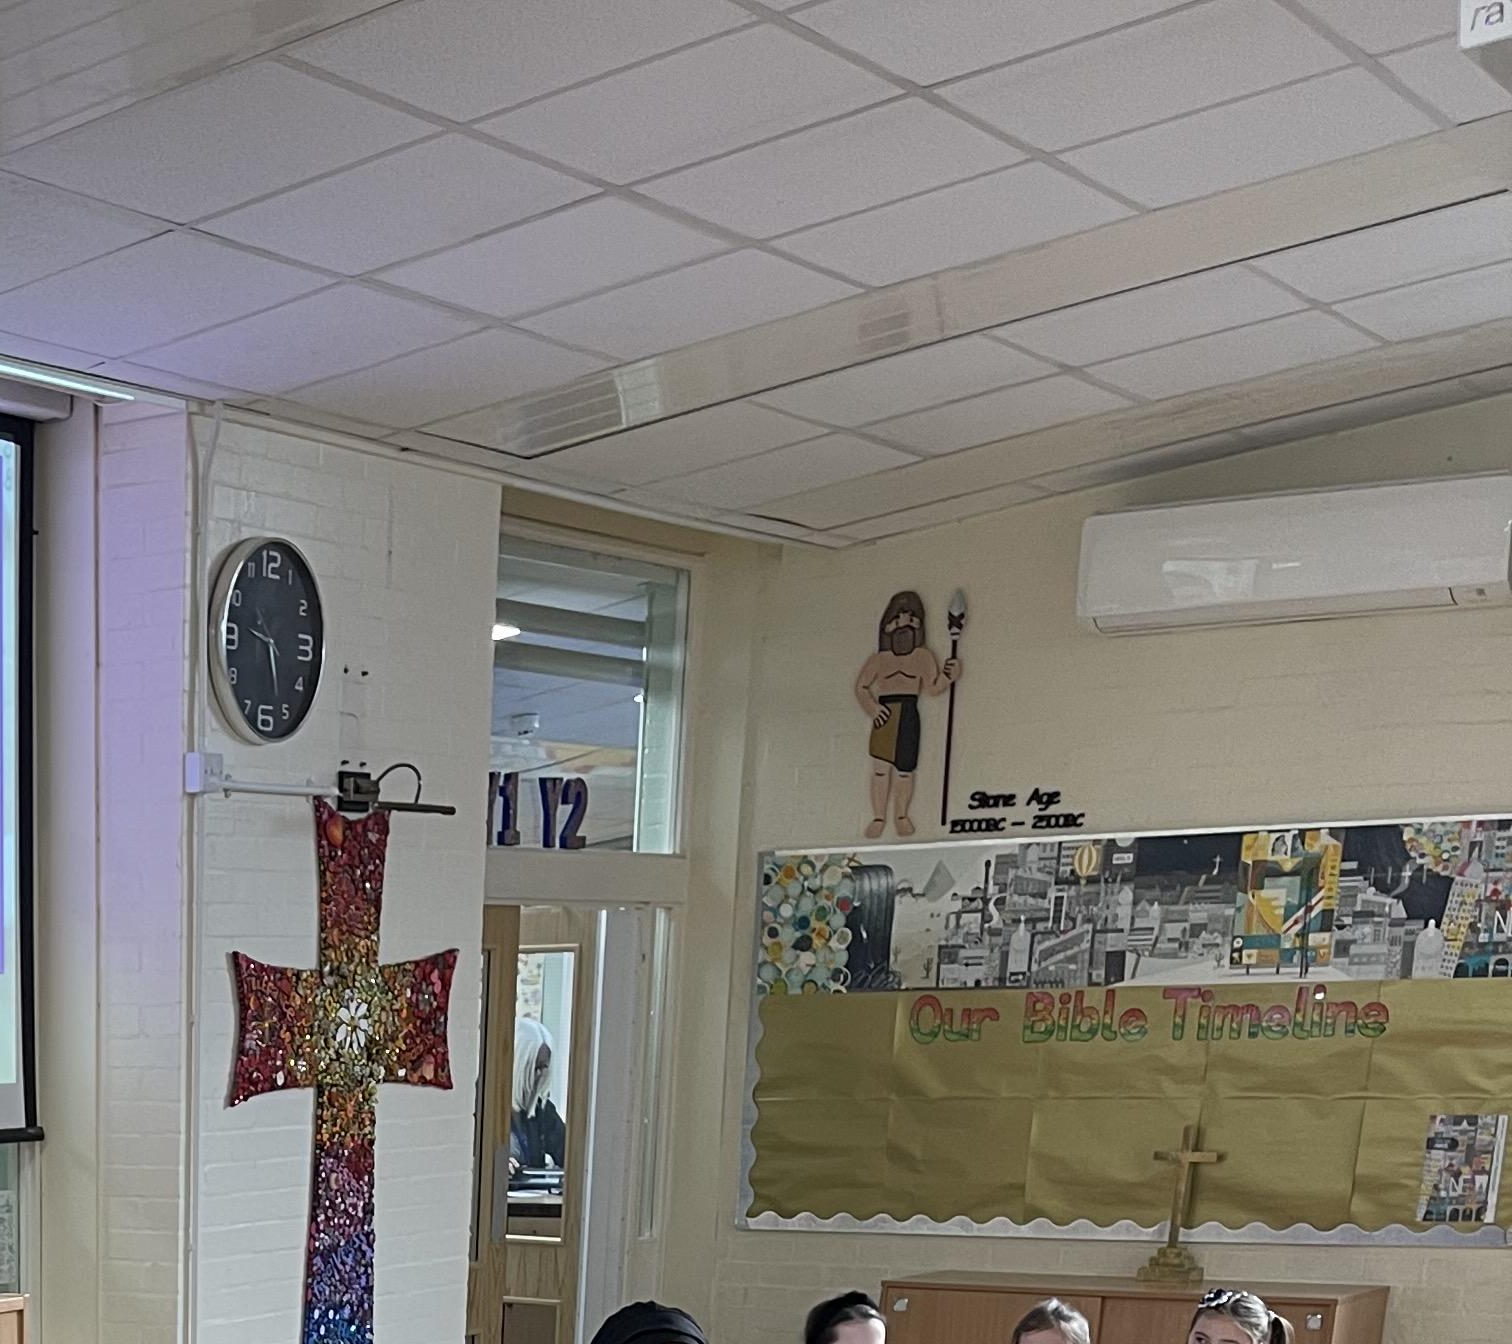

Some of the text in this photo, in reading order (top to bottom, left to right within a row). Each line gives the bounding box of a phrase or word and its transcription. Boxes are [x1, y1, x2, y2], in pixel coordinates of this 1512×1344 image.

[262, 550, 281, 580] 12
[299, 600, 308, 616] 2
[297, 634, 314, 661] 3
[294, 677, 304, 692] 4
[243, 700, 252, 715] 7
[257, 705, 274, 731] 6
[281, 704, 289, 719] 5
[968, 788, 1061, 811] Stone Age
[538, 777, 588, 849] Y2
[908, 984, 1389, 1045] Our Bible Timeline
